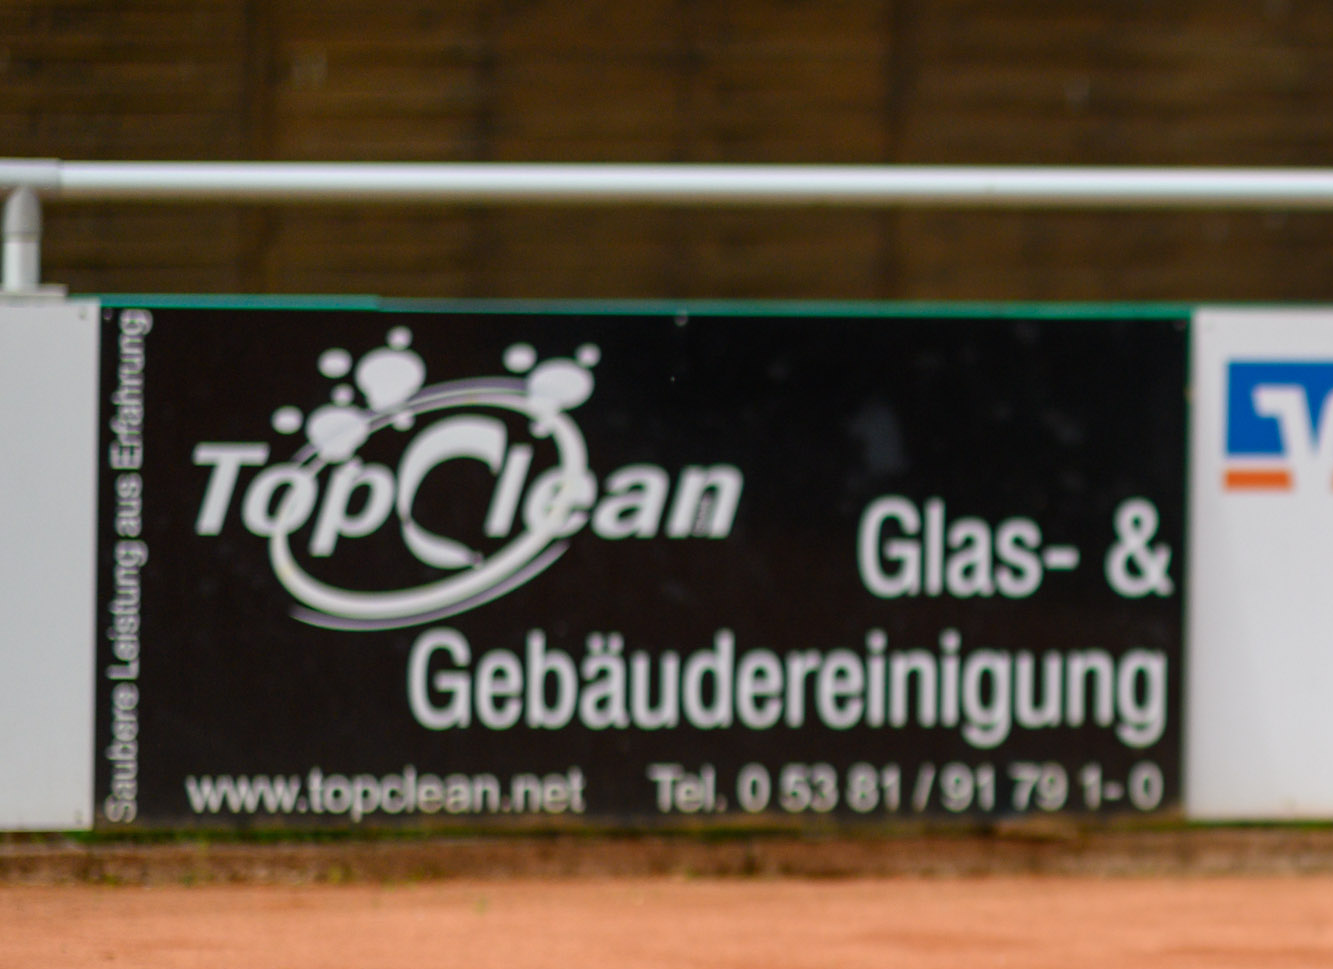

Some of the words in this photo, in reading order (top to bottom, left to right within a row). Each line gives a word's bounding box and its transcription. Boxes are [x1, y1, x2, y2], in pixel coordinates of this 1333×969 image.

[109, 308, 154, 470] Erfahrung
[115, 473, 144, 538] aus
[192, 414, 744, 569] TopClean
[858, 496, 1080, 598] Glas-
[1106, 499, 1173, 597] &
[107, 539, 149, 681] Leistung
[407, 628, 1168, 748] Gebäudereinigung
[103, 683, 140, 824] Saubere
[185, 766, 585, 822] www.topclean.net
[649, 763, 727, 812] Tel.
[736, 763, 772, 813] 0
[779, 763, 840, 812] 53
[846, 764, 902, 812] 81
[940, 763, 996, 812] 91
[1011, 762, 1069, 811] 79
